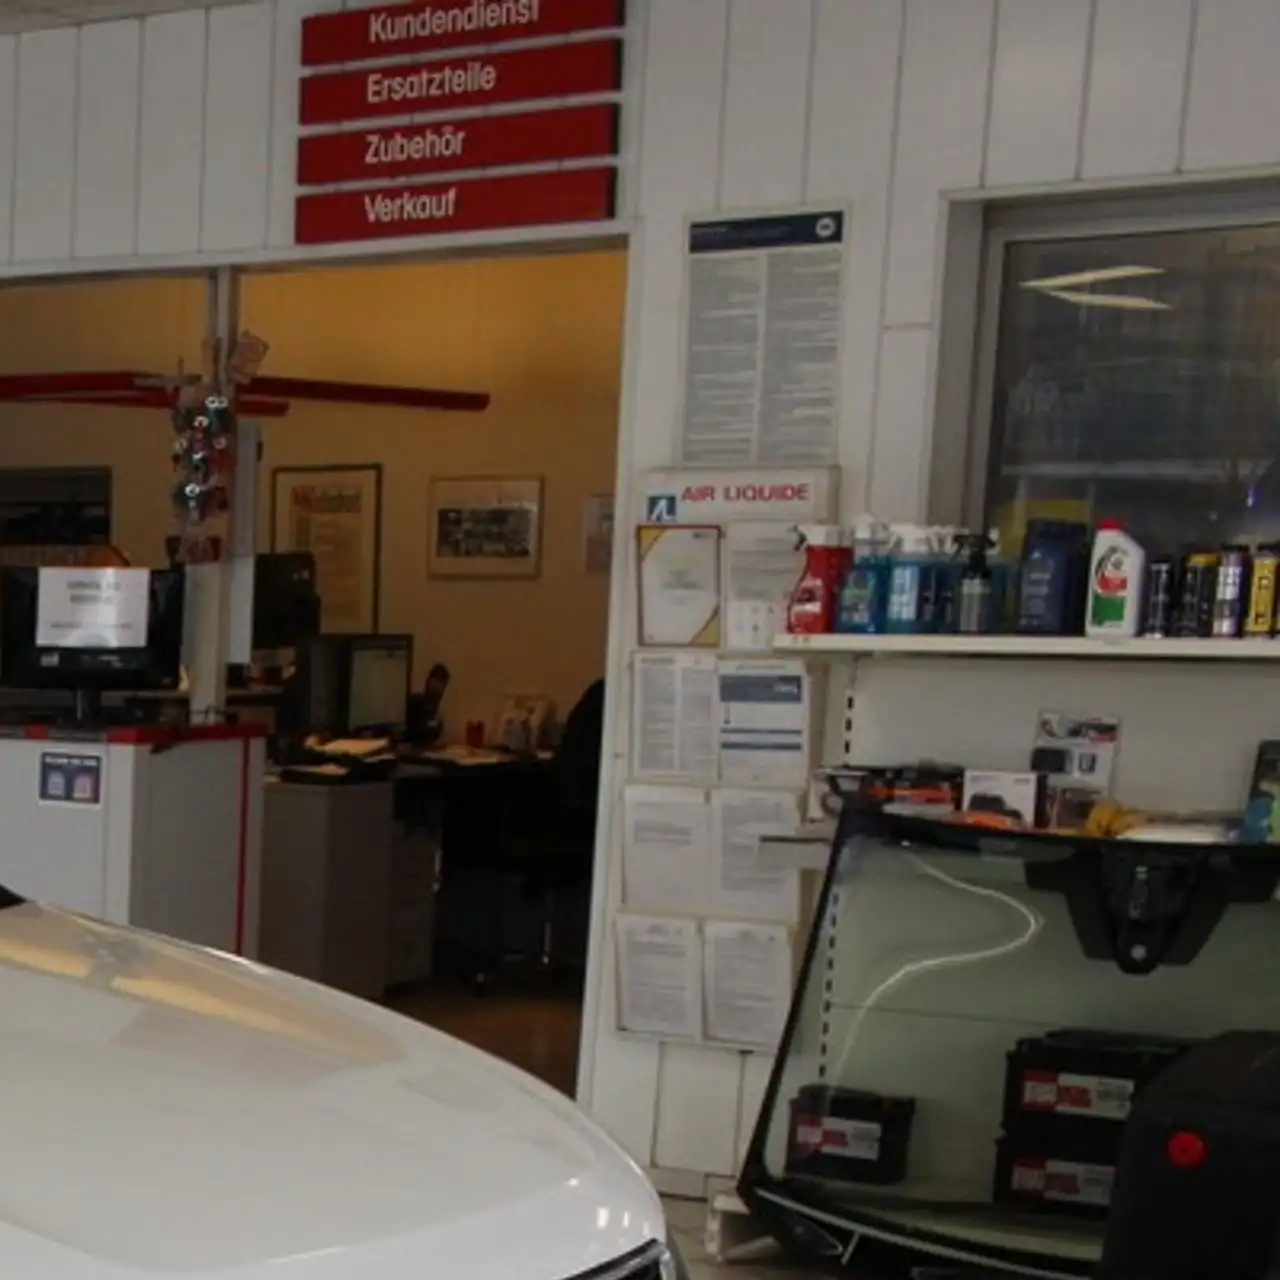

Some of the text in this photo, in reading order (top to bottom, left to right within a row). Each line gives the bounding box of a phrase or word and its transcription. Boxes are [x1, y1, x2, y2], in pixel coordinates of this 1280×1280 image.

[369, 0, 539, 43] Kundendienst
[366, 61, 497, 103] Ersatzteile
[365, 125, 465, 165] Zubehör
[364, 188, 456, 223] Verkauf
[681, 482, 811, 503] AIR LIQUIDE
